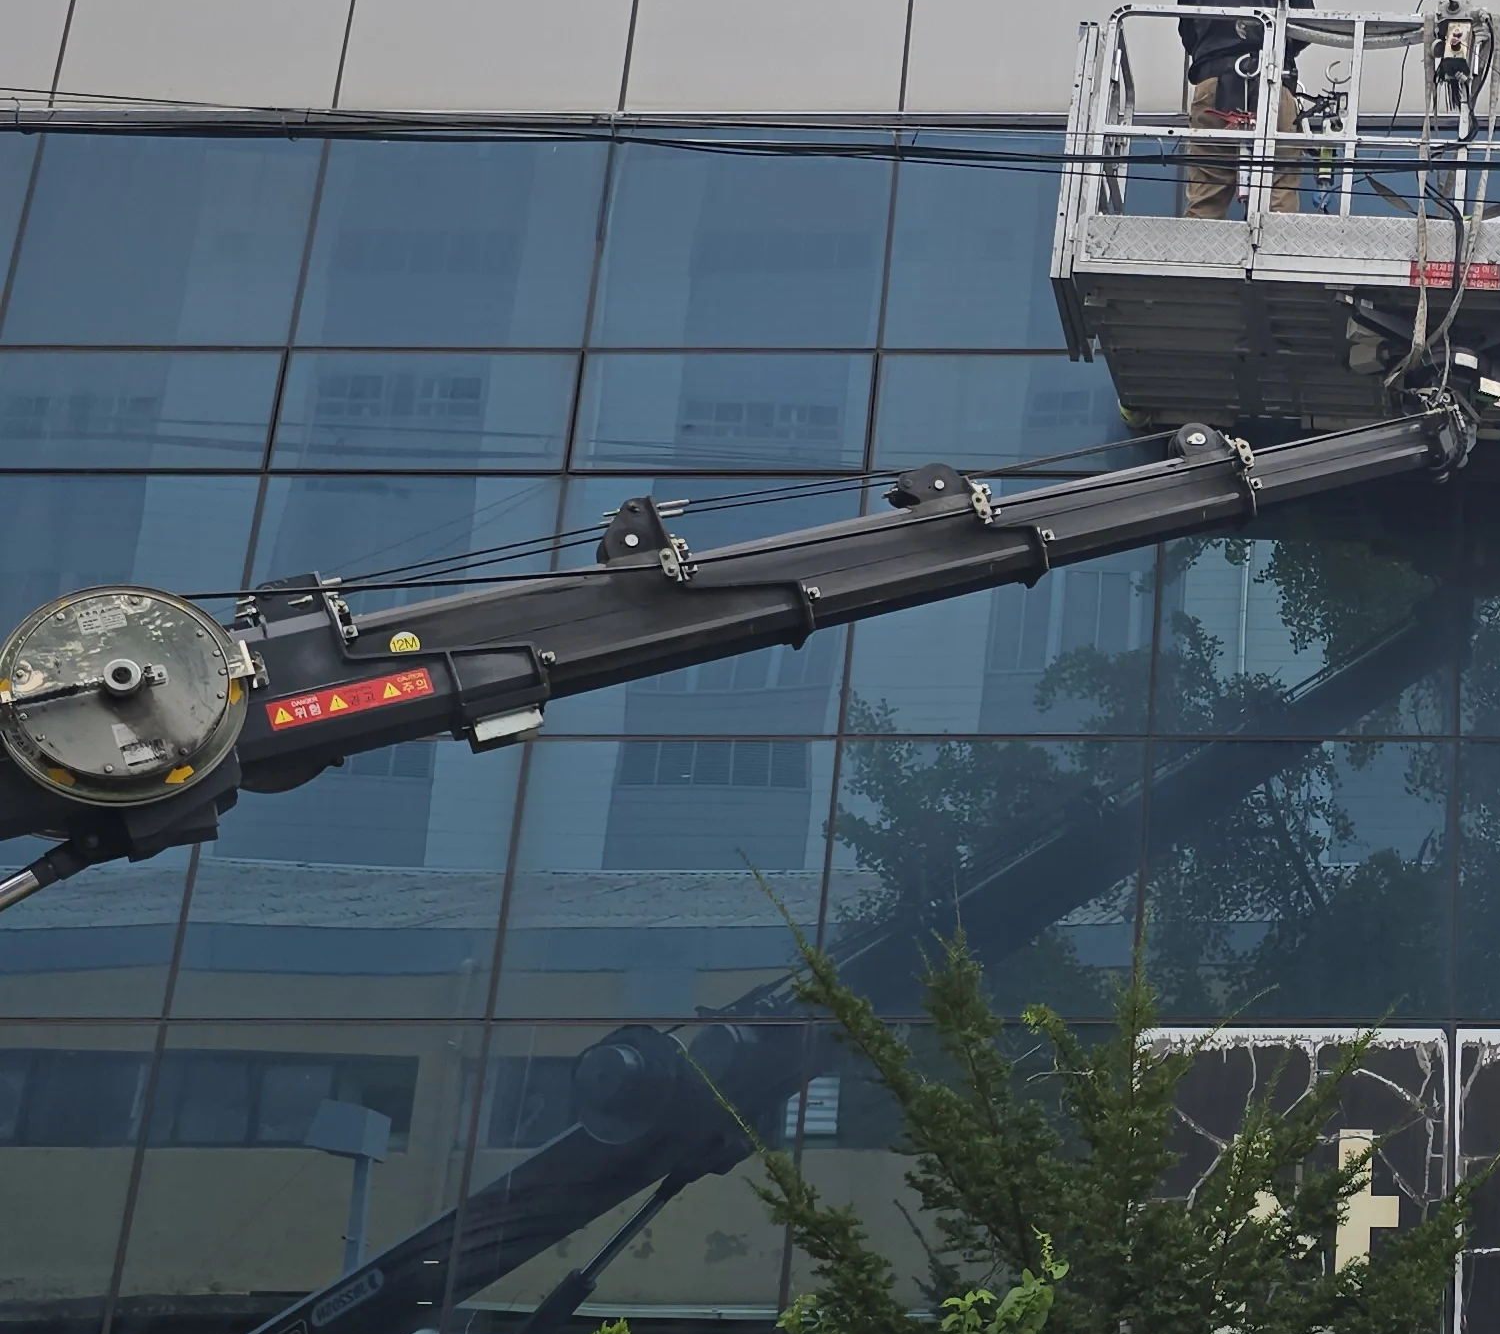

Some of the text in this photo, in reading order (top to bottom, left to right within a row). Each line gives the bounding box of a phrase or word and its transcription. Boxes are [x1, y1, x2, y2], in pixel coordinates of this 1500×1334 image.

[391, 636, 418, 652] 12M
[402, 679, 429, 694] 주의
[294, 703, 322, 719] 위험
